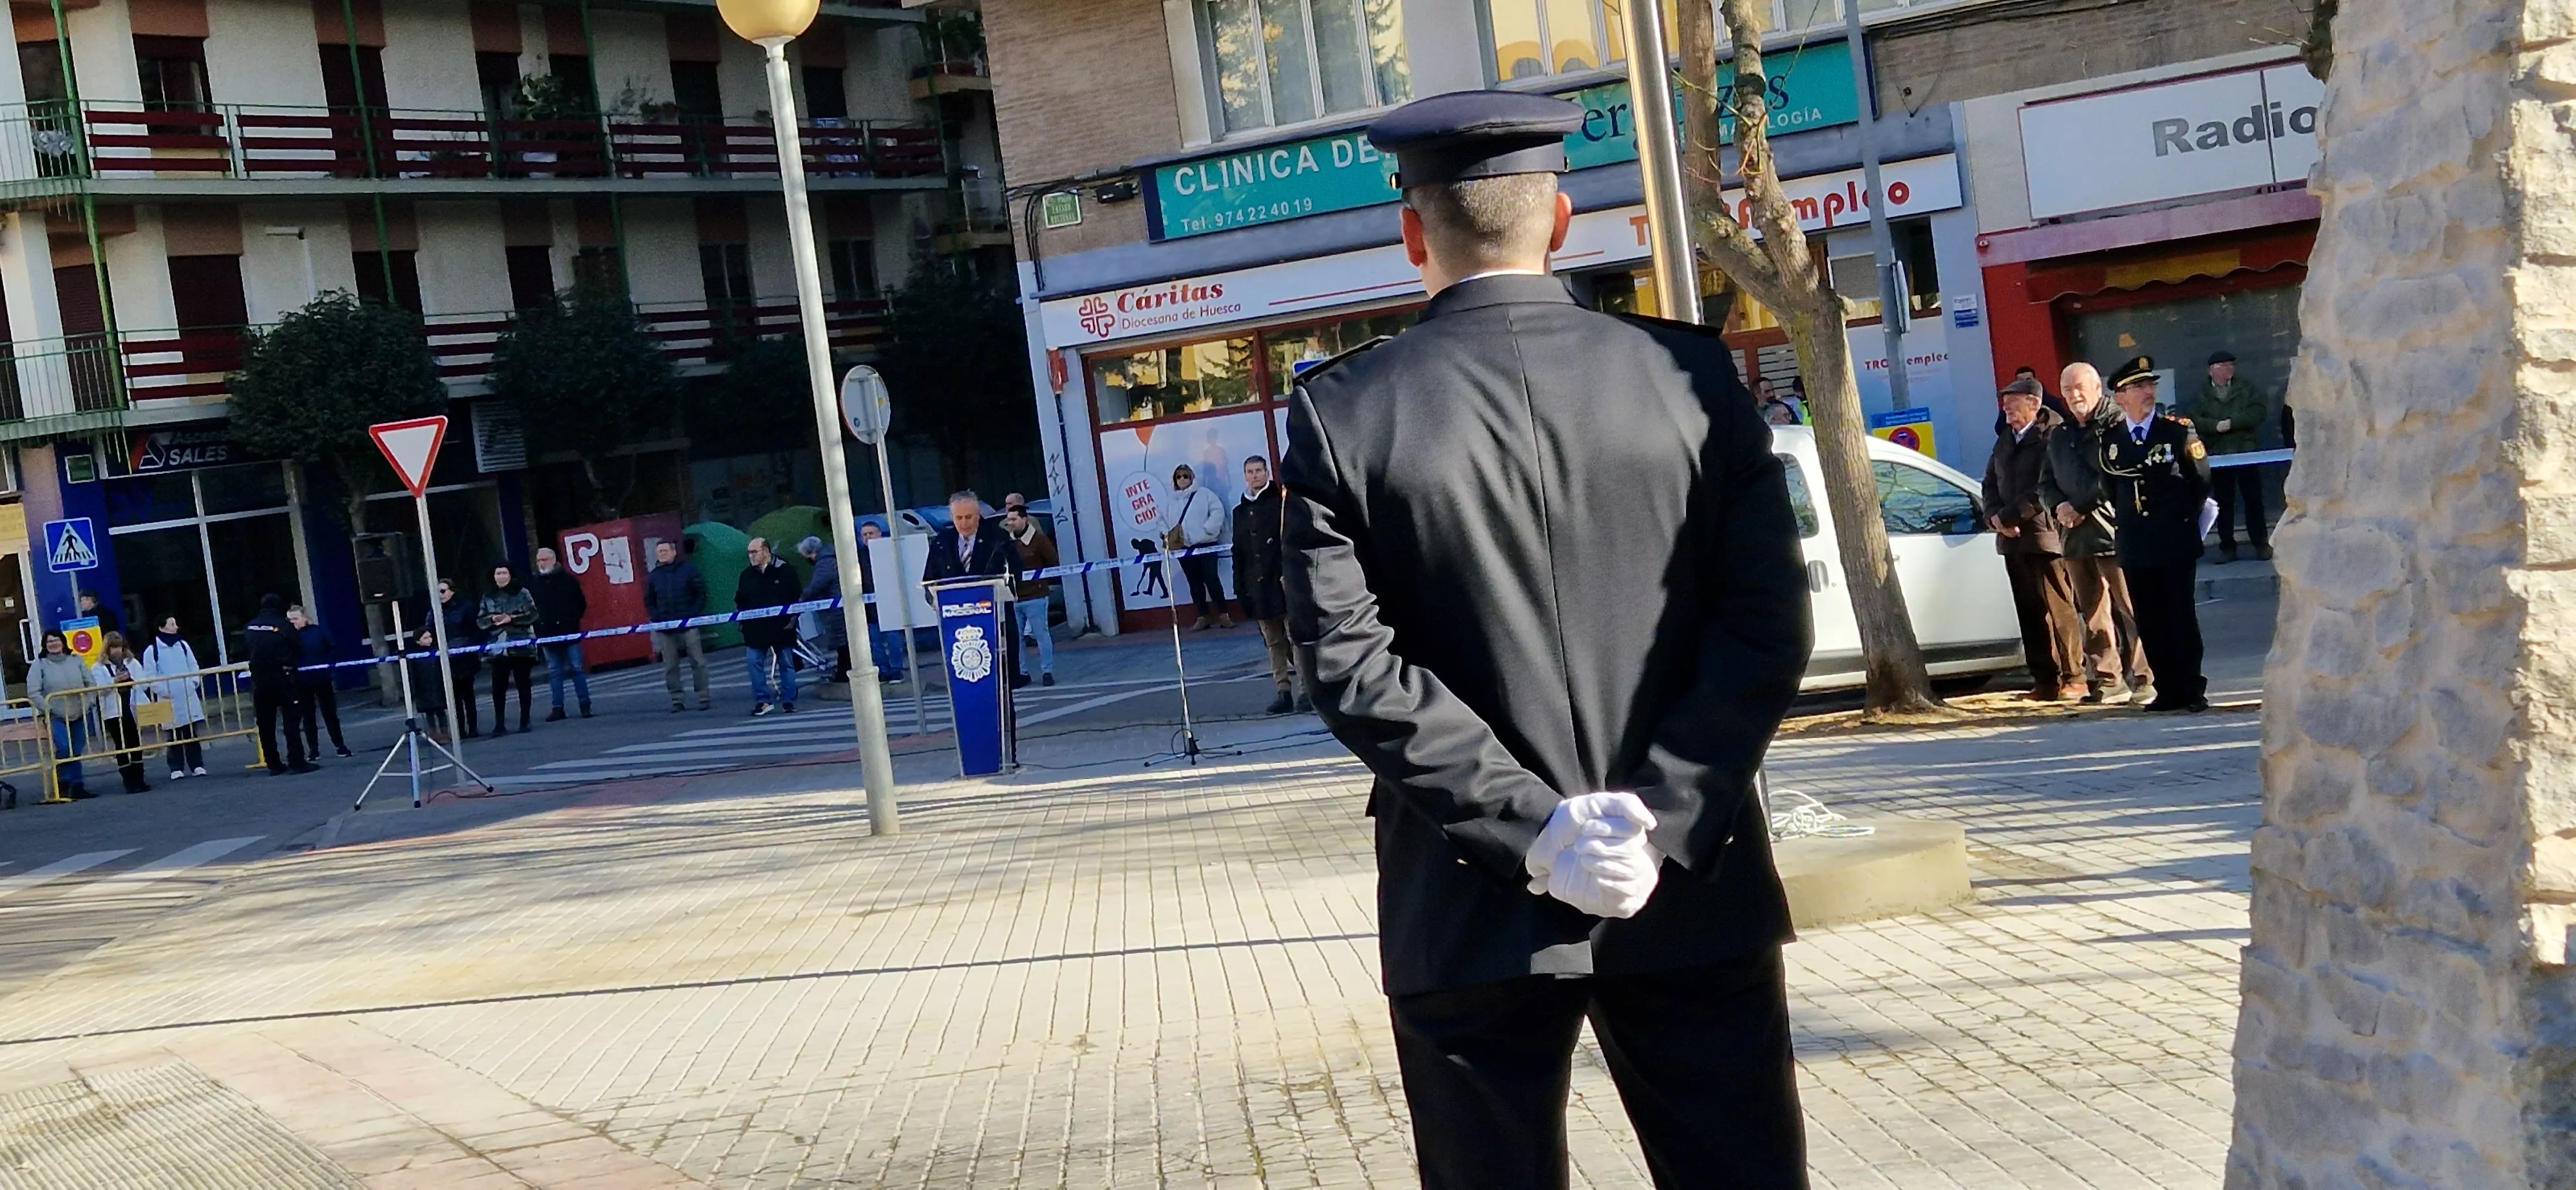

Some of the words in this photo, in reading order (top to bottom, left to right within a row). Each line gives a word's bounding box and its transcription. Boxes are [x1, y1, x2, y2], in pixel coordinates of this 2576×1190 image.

[1331, 135, 1391, 168] DE
[1180, 216, 1211, 232] Tel.
[1117, 283, 1224, 314] Cáritas
[1122, 313, 1179, 330] Diocesana
[1182, 307, 1196, 320] de
[1200, 303, 1242, 317] Huesca
[169, 445, 227, 466] SALES
[1125, 479, 1150, 498] INTE
[1132, 493, 1155, 511] GRA
